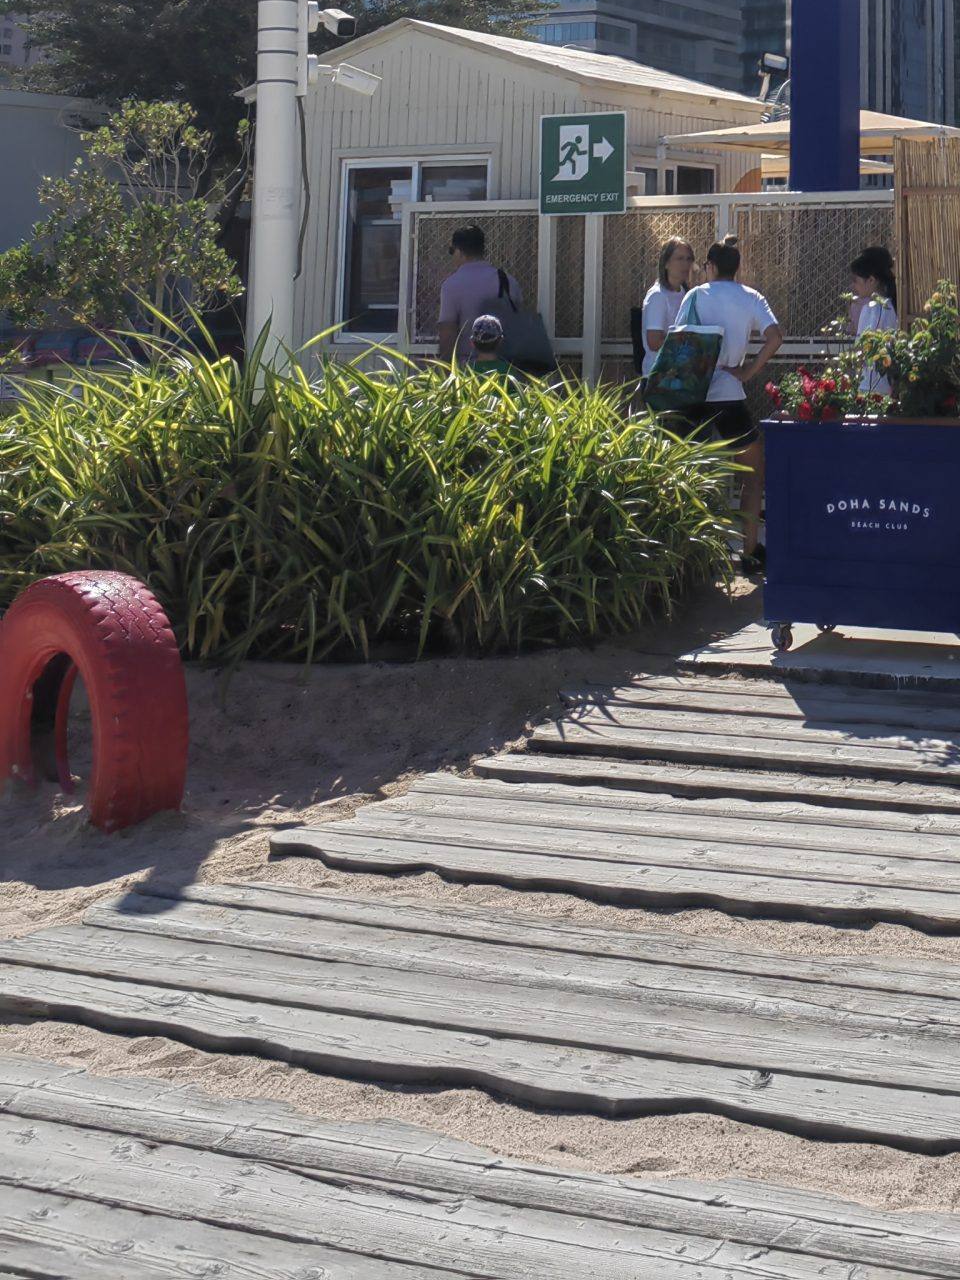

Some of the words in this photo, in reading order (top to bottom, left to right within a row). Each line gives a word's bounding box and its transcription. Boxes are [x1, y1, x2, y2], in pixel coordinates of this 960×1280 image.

[546, 193, 598, 203] EMERGENCY
[600, 192, 619, 202] EXIT
[827, 498, 870, 514] DOHA
[879, 498, 930, 518] SANDS
[851, 521, 880, 529] BEACH
[886, 522, 908, 531] CLUB
